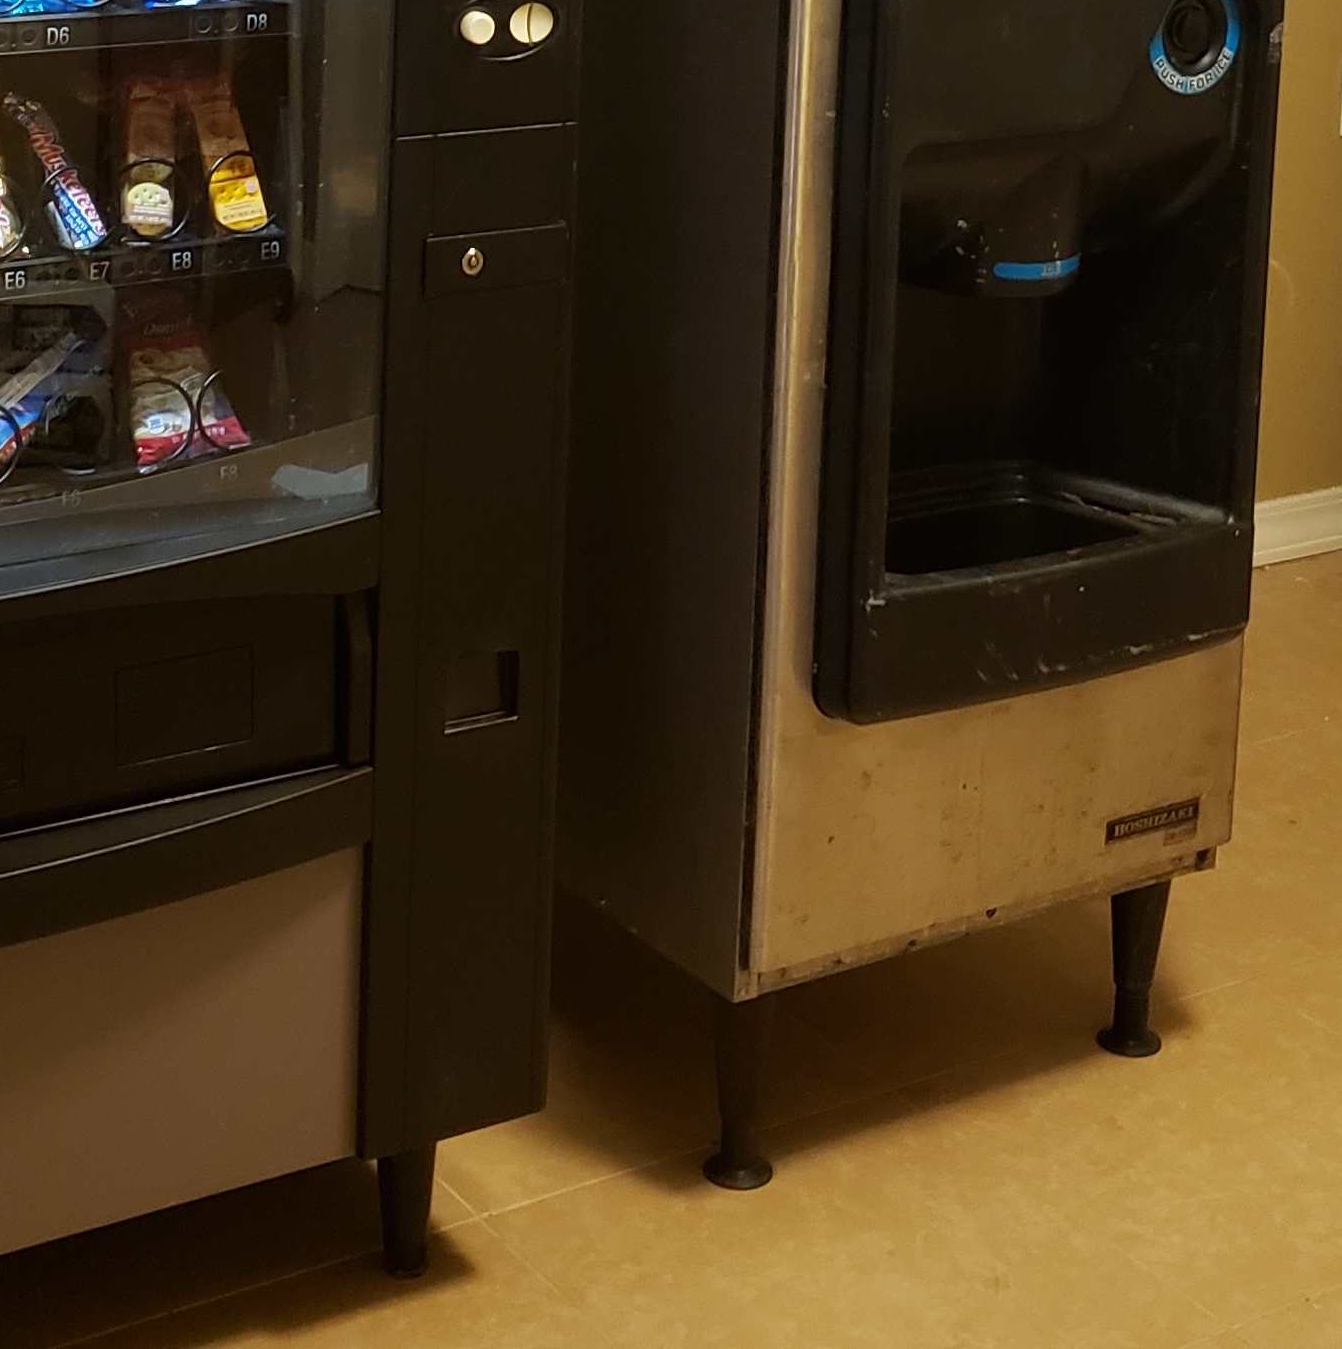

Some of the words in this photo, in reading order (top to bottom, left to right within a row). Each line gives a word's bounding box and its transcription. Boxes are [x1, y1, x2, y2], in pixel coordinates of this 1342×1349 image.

[246, 12, 268, 32] D8
[46, 26, 70, 47] D6
[1155, 58, 1185, 90] PUSH
[1188, 72, 1214, 91] FOR
[1214, 51, 1232, 75] ICE
[261, 240, 281, 260] E9
[89, 261, 110, 281] E7
[172, 251, 193, 271] E8
[5, 270, 26, 291] E6
[220, 465, 238, 482] F8
